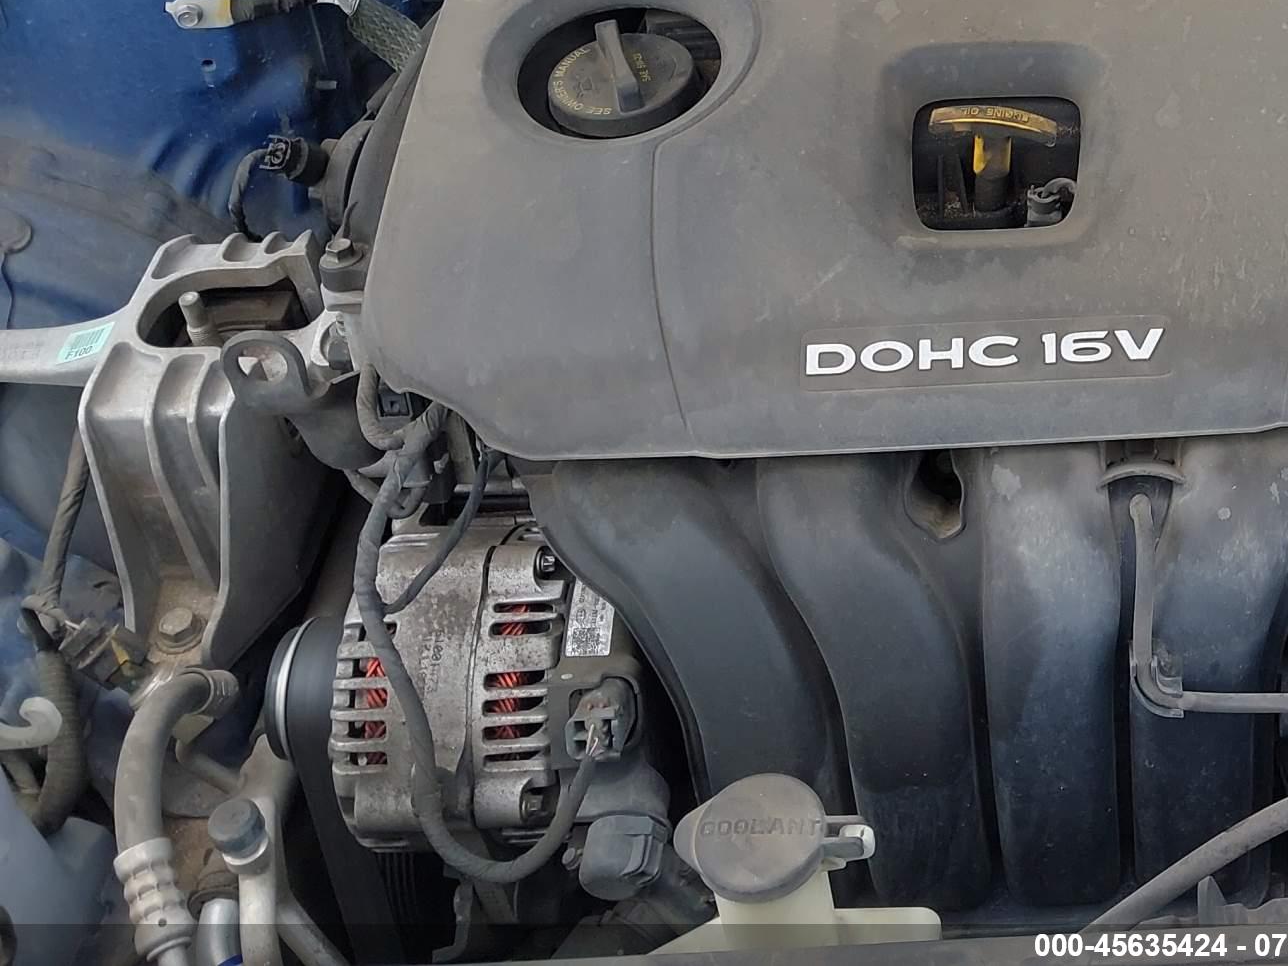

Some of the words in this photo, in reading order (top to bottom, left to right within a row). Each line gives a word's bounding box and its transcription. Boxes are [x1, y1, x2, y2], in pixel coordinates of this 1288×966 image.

[554, 48, 591, 78] MANUAL
[586, 106, 612, 115] SEE
[960, 107, 980, 115] OIL
[987, 108, 1030, 123] ENGINE
[64, 345, 93, 361] F100
[805, 335, 1020, 376] DOHC
[1041, 327, 1164, 365] 16V
[702, 817, 821, 837] COOLANT
